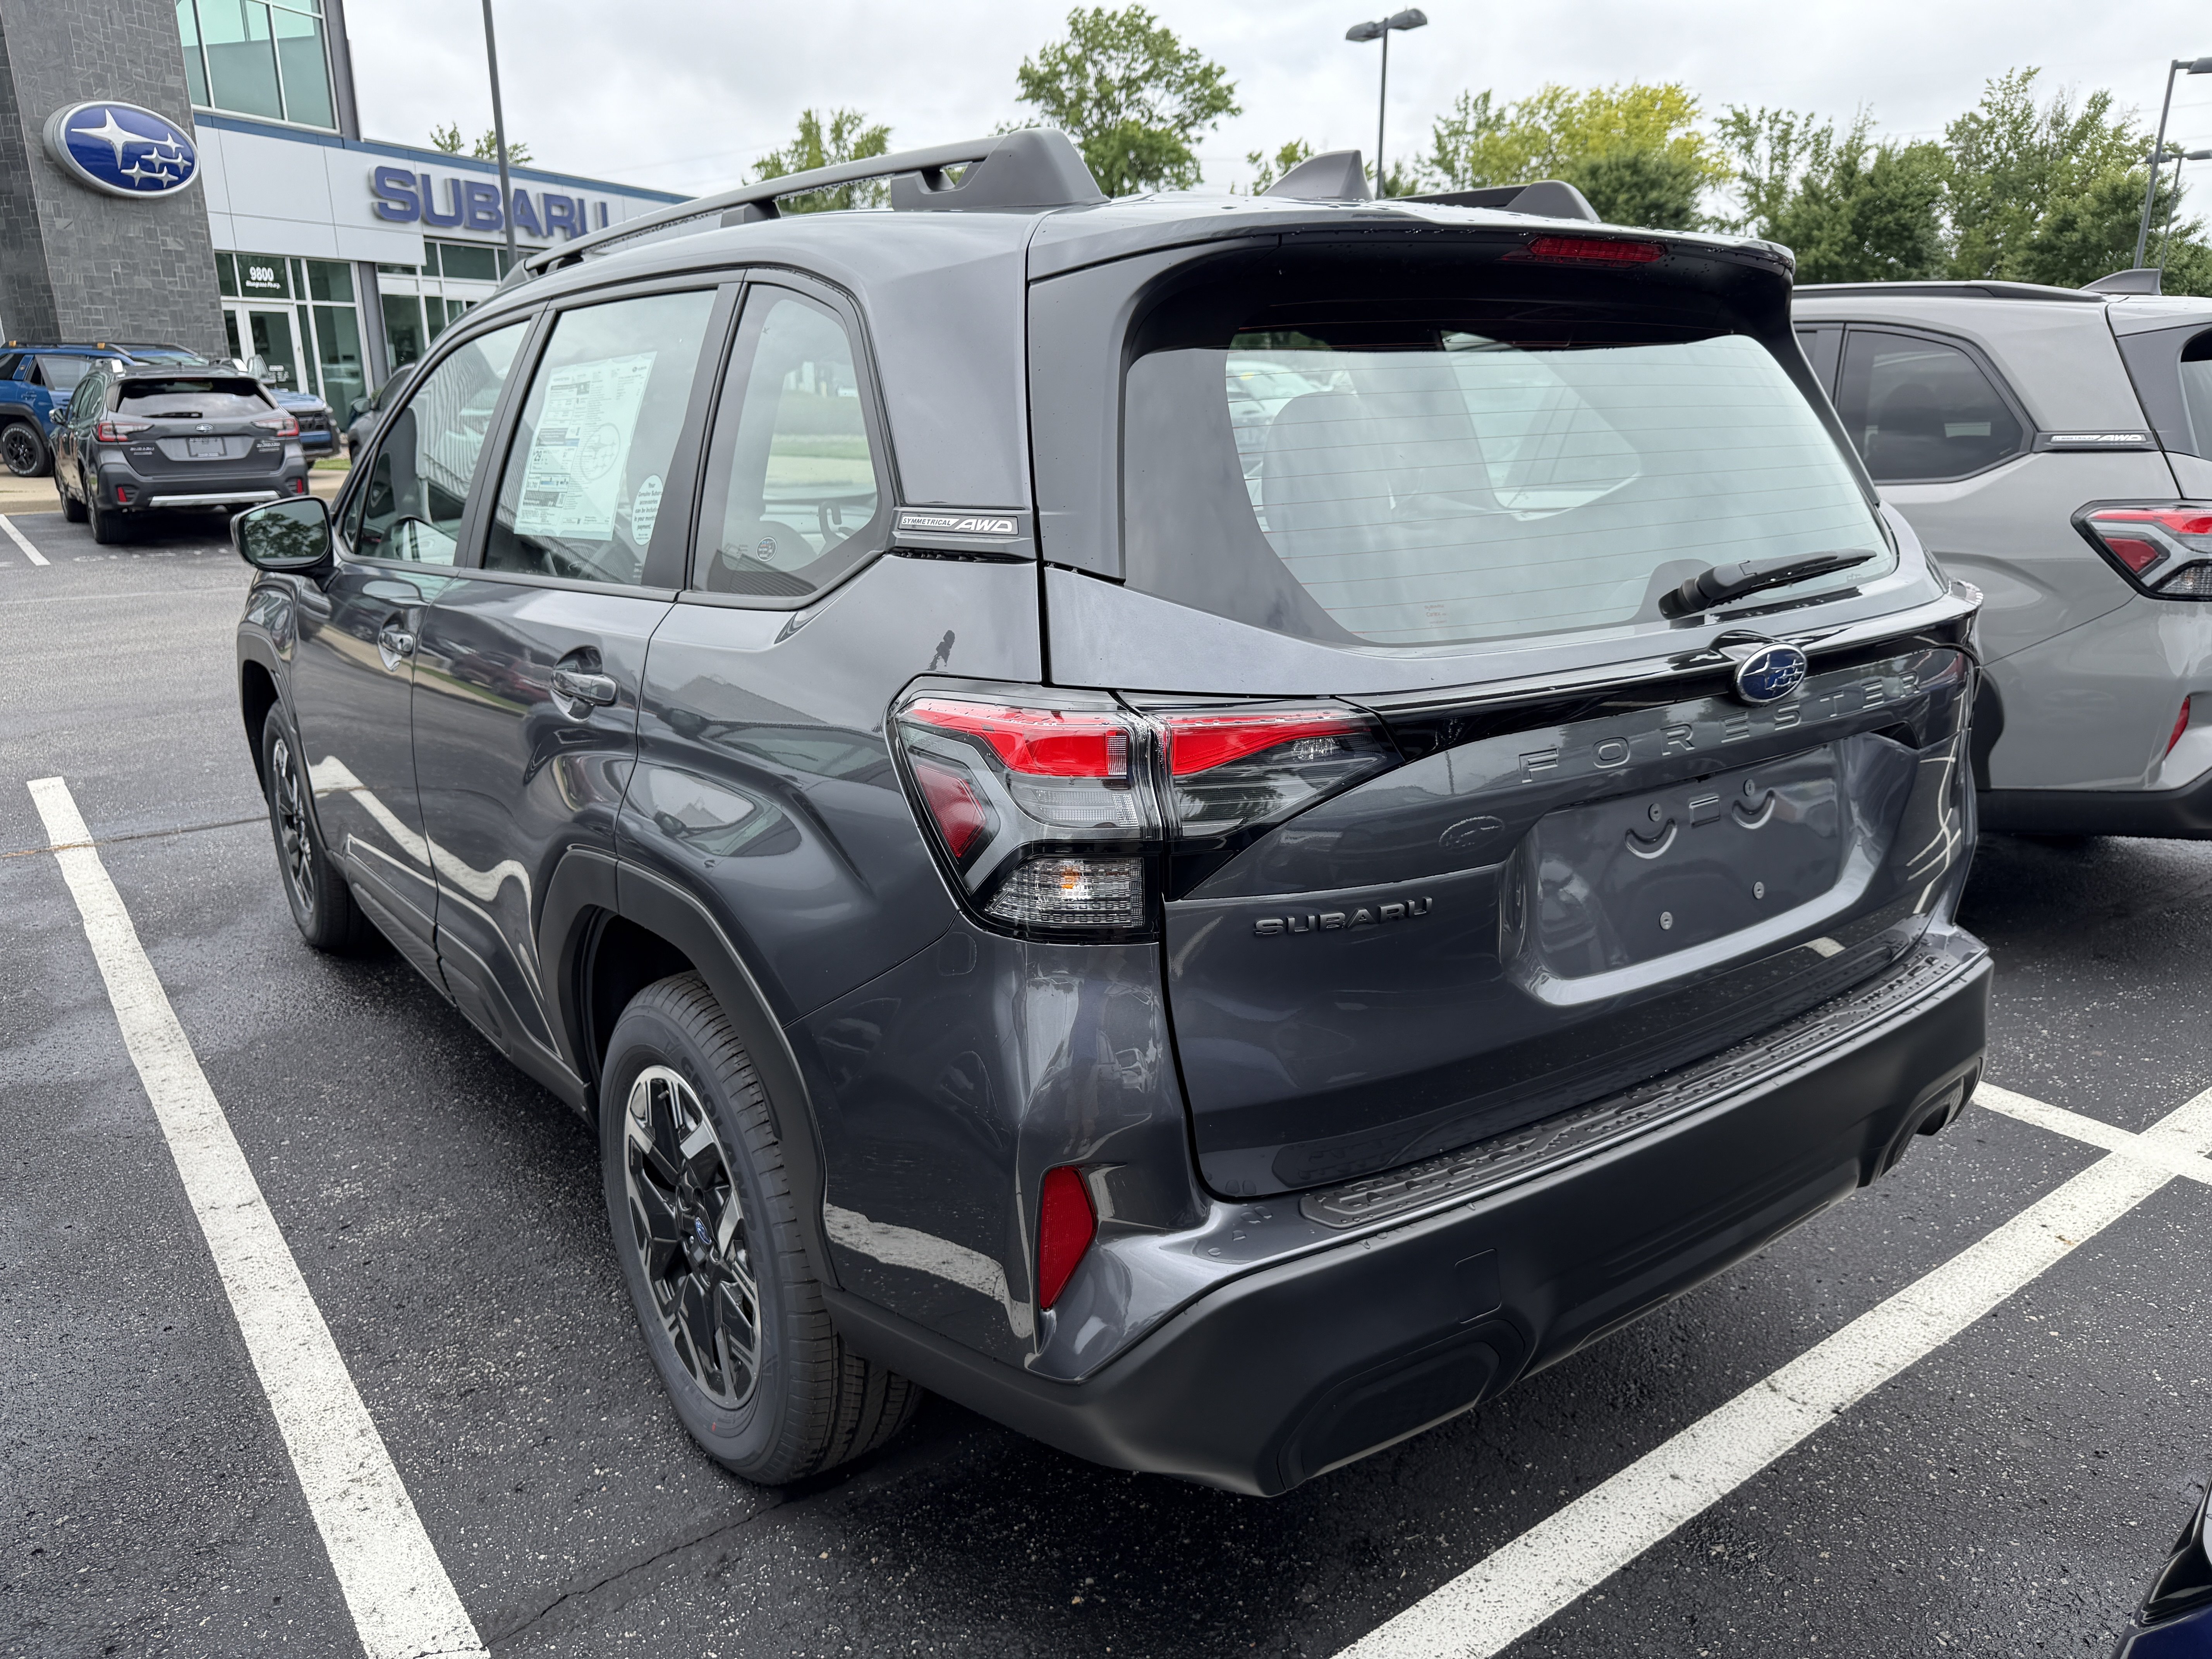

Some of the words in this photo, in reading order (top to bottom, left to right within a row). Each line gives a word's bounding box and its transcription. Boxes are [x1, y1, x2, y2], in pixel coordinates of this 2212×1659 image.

[370, 165, 609, 238] SUBARU
[249, 266, 274, 282] 9800
[902, 517, 952, 527] SYMMETRICAL
[954, 519, 1013, 532] AWD
[1519, 670, 1922, 784] FORESTER
[910, 734, 945, 750] SUBARU
[1253, 896, 1432, 936] SUBARU
